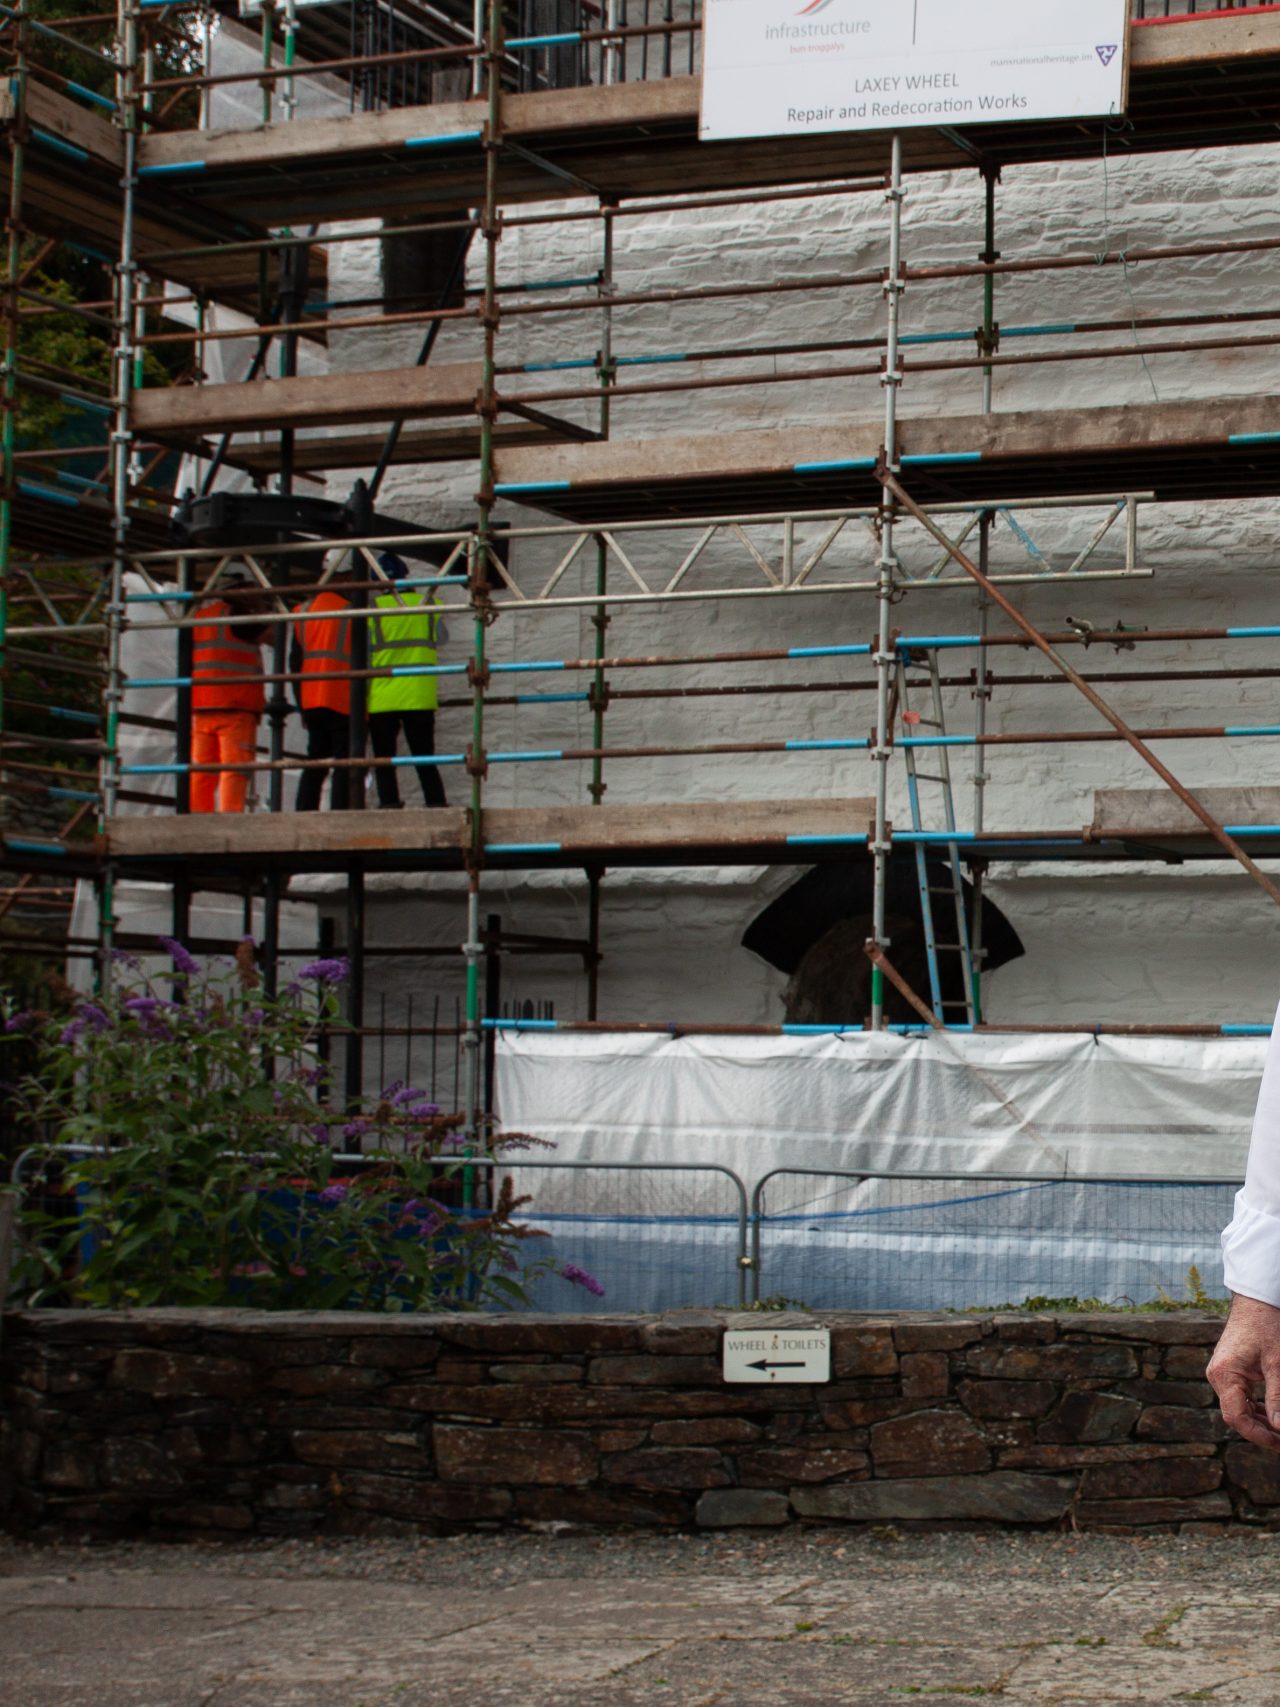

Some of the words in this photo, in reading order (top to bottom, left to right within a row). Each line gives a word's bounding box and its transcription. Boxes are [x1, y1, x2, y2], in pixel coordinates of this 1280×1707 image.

[765, 20, 872, 40] infrastructure
[855, 76, 901, 93] LAXEY
[905, 73, 959, 89] WHEEL
[787, 105, 834, 124] Repair
[838, 102, 867, 118] and
[872, 97, 973, 117] Redecoration
[978, 93, 1028, 109] Works
[728, 1340, 767, 1351] WHEEL
[771, 1341, 779, 1350] &
[782, 1339, 826, 1350] TOILETS
